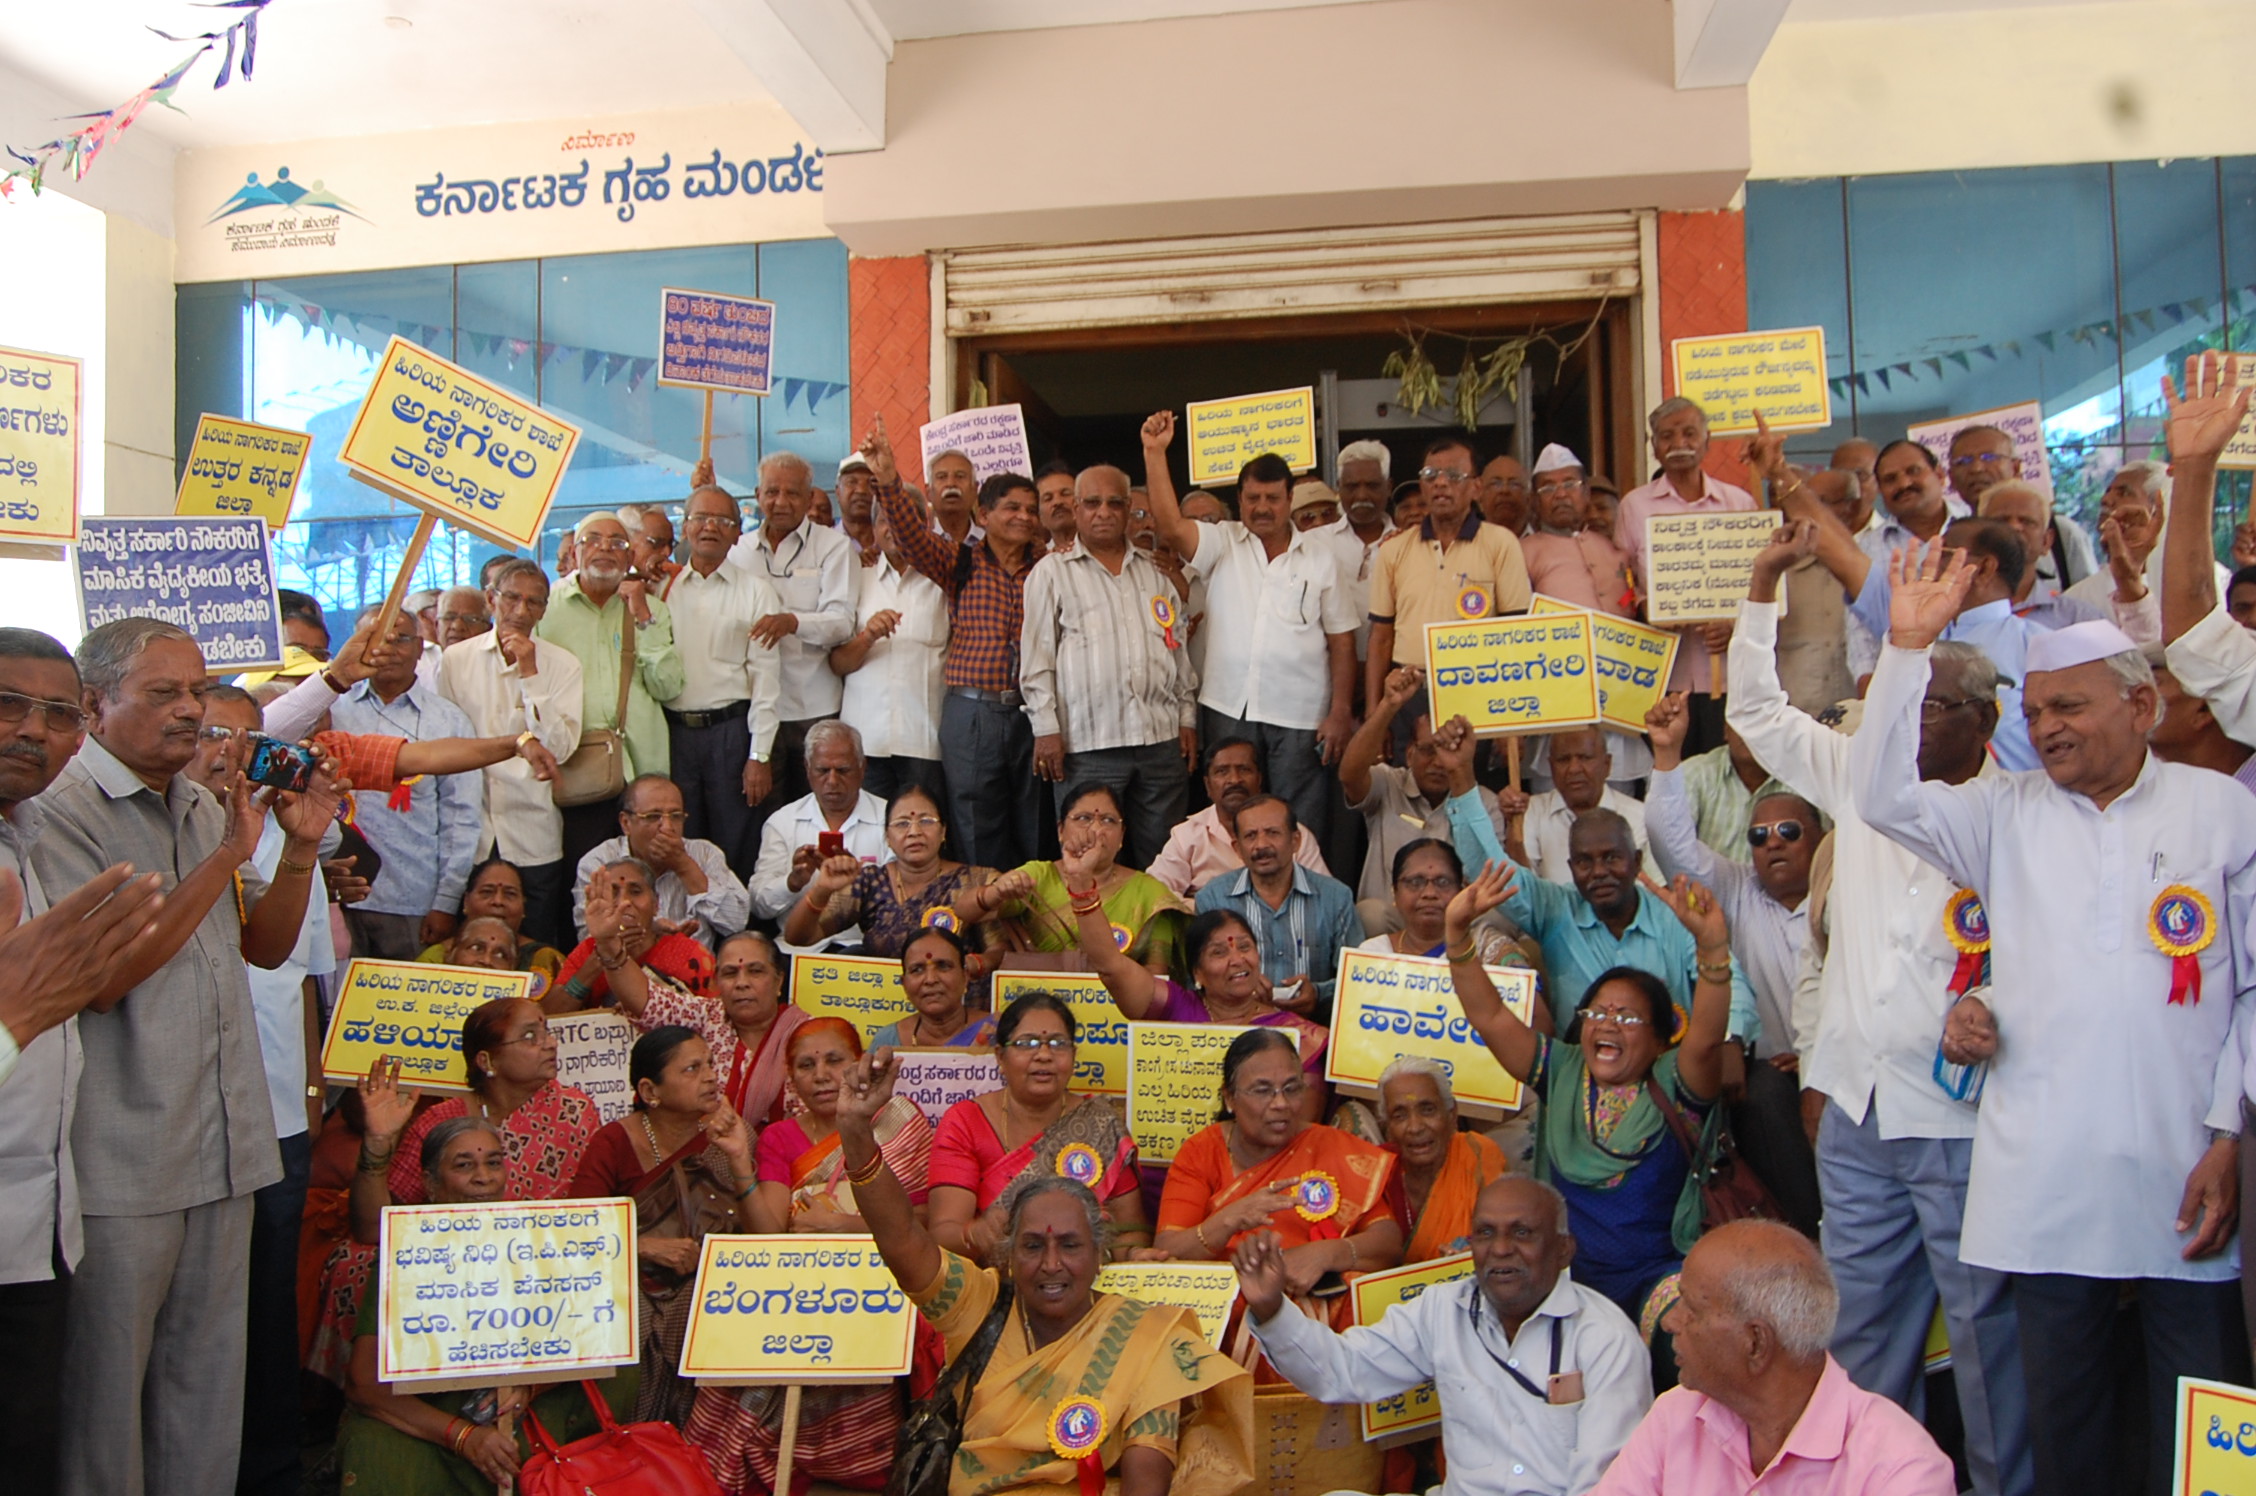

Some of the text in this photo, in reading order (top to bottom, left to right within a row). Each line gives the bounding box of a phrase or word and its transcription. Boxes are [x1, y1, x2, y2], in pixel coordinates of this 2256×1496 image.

[414, 158, 590, 217] ಕರ್ನಾಟಕ
[603, 152, 671, 223] ಗೃಹ
[394, 356, 564, 452] ಹಿರಿಯ ನಾಗರಿಕರ ಶಾಖೆ
[202, 426, 233, 444] ಹಿರಿಯ
[234, 433, 279, 454] ನಾಗರಿಕರ
[191, 456, 295, 497] ಉತ್ತರ ಕನ್ನಡ
[82, 523, 260, 561] ನಿವೃತ್ತ ಸರ್ಕಾರಿ ನೌಕರರಿಗೆ
[83, 559, 270, 599] ಮಾಸಿಕ ವೈದ್ಯಕೀಯ ಭತ್ಯೆ
[198, 599, 270, 625] ಸಂಜೀವಿನಿ
[199, 633, 267, 661] ಡಬೇಕು
[1436, 621, 1581, 650] ಹಿರಿಯ ನಾಗರಿಕರ ಶಾಖೆ
[1436, 651, 1586, 688] ದಾವಣಗೇರಿ
[1596, 654, 1659, 688] ವಾಡ
[1488, 695, 1541, 718] ಜಿಲ್ಲಾ
[355, 972, 403, 991] ಹಿರಿಯ
[406, 976, 479, 998] ನಾಗರಿಕರ
[812, 966, 838, 985] ಪ್ರತಿ
[848, 970, 884, 989] ಜಿಲ್ಲಾ
[1351, 965, 1399, 987] ಹಿರಿಯ
[376, 999, 419, 1015] ಉ.ಕ.
[1141, 1031, 1189, 1055] ಜಿಲ್ಲಾ
[566, 1048, 628, 1075] ನಾಗರಿಕರಿಗೆ
[924, 1064, 987, 1081] ಸರ್ಕಾರದ
[1138, 1083, 1167, 1105] ಎಲ್ಲ
[1167, 1083, 1213, 1100] ಹಿರಿಯ
[1137, 1108, 1176, 1124] ಉಚಿತ
[420, 1210, 600, 1234] ಹಿರಿಯ ನಾಗರಿಕರಿಗೆ
[395, 1244, 457, 1275] ಭವಿಷ್ಯ
[463, 1243, 498, 1264] ನಿಧಿ
[715, 1249, 772, 1268] ಹಿರಿಯ
[777, 1249, 863, 1268] ನಾಗರಿಕರ
[416, 1277, 499, 1301] ಮಾಸಿಕ
[704, 1280, 905, 1315] ಬೆಂಗಳೂರು
[1102, 1273, 1139, 1296] ಜಿಲ್ಲಾ
[402, 1311, 457, 1335] ರೂ.
[593, 1299, 615, 1323] ಗೆ
[761, 1334, 834, 1364] ಜಿಲ್ಲಾ
